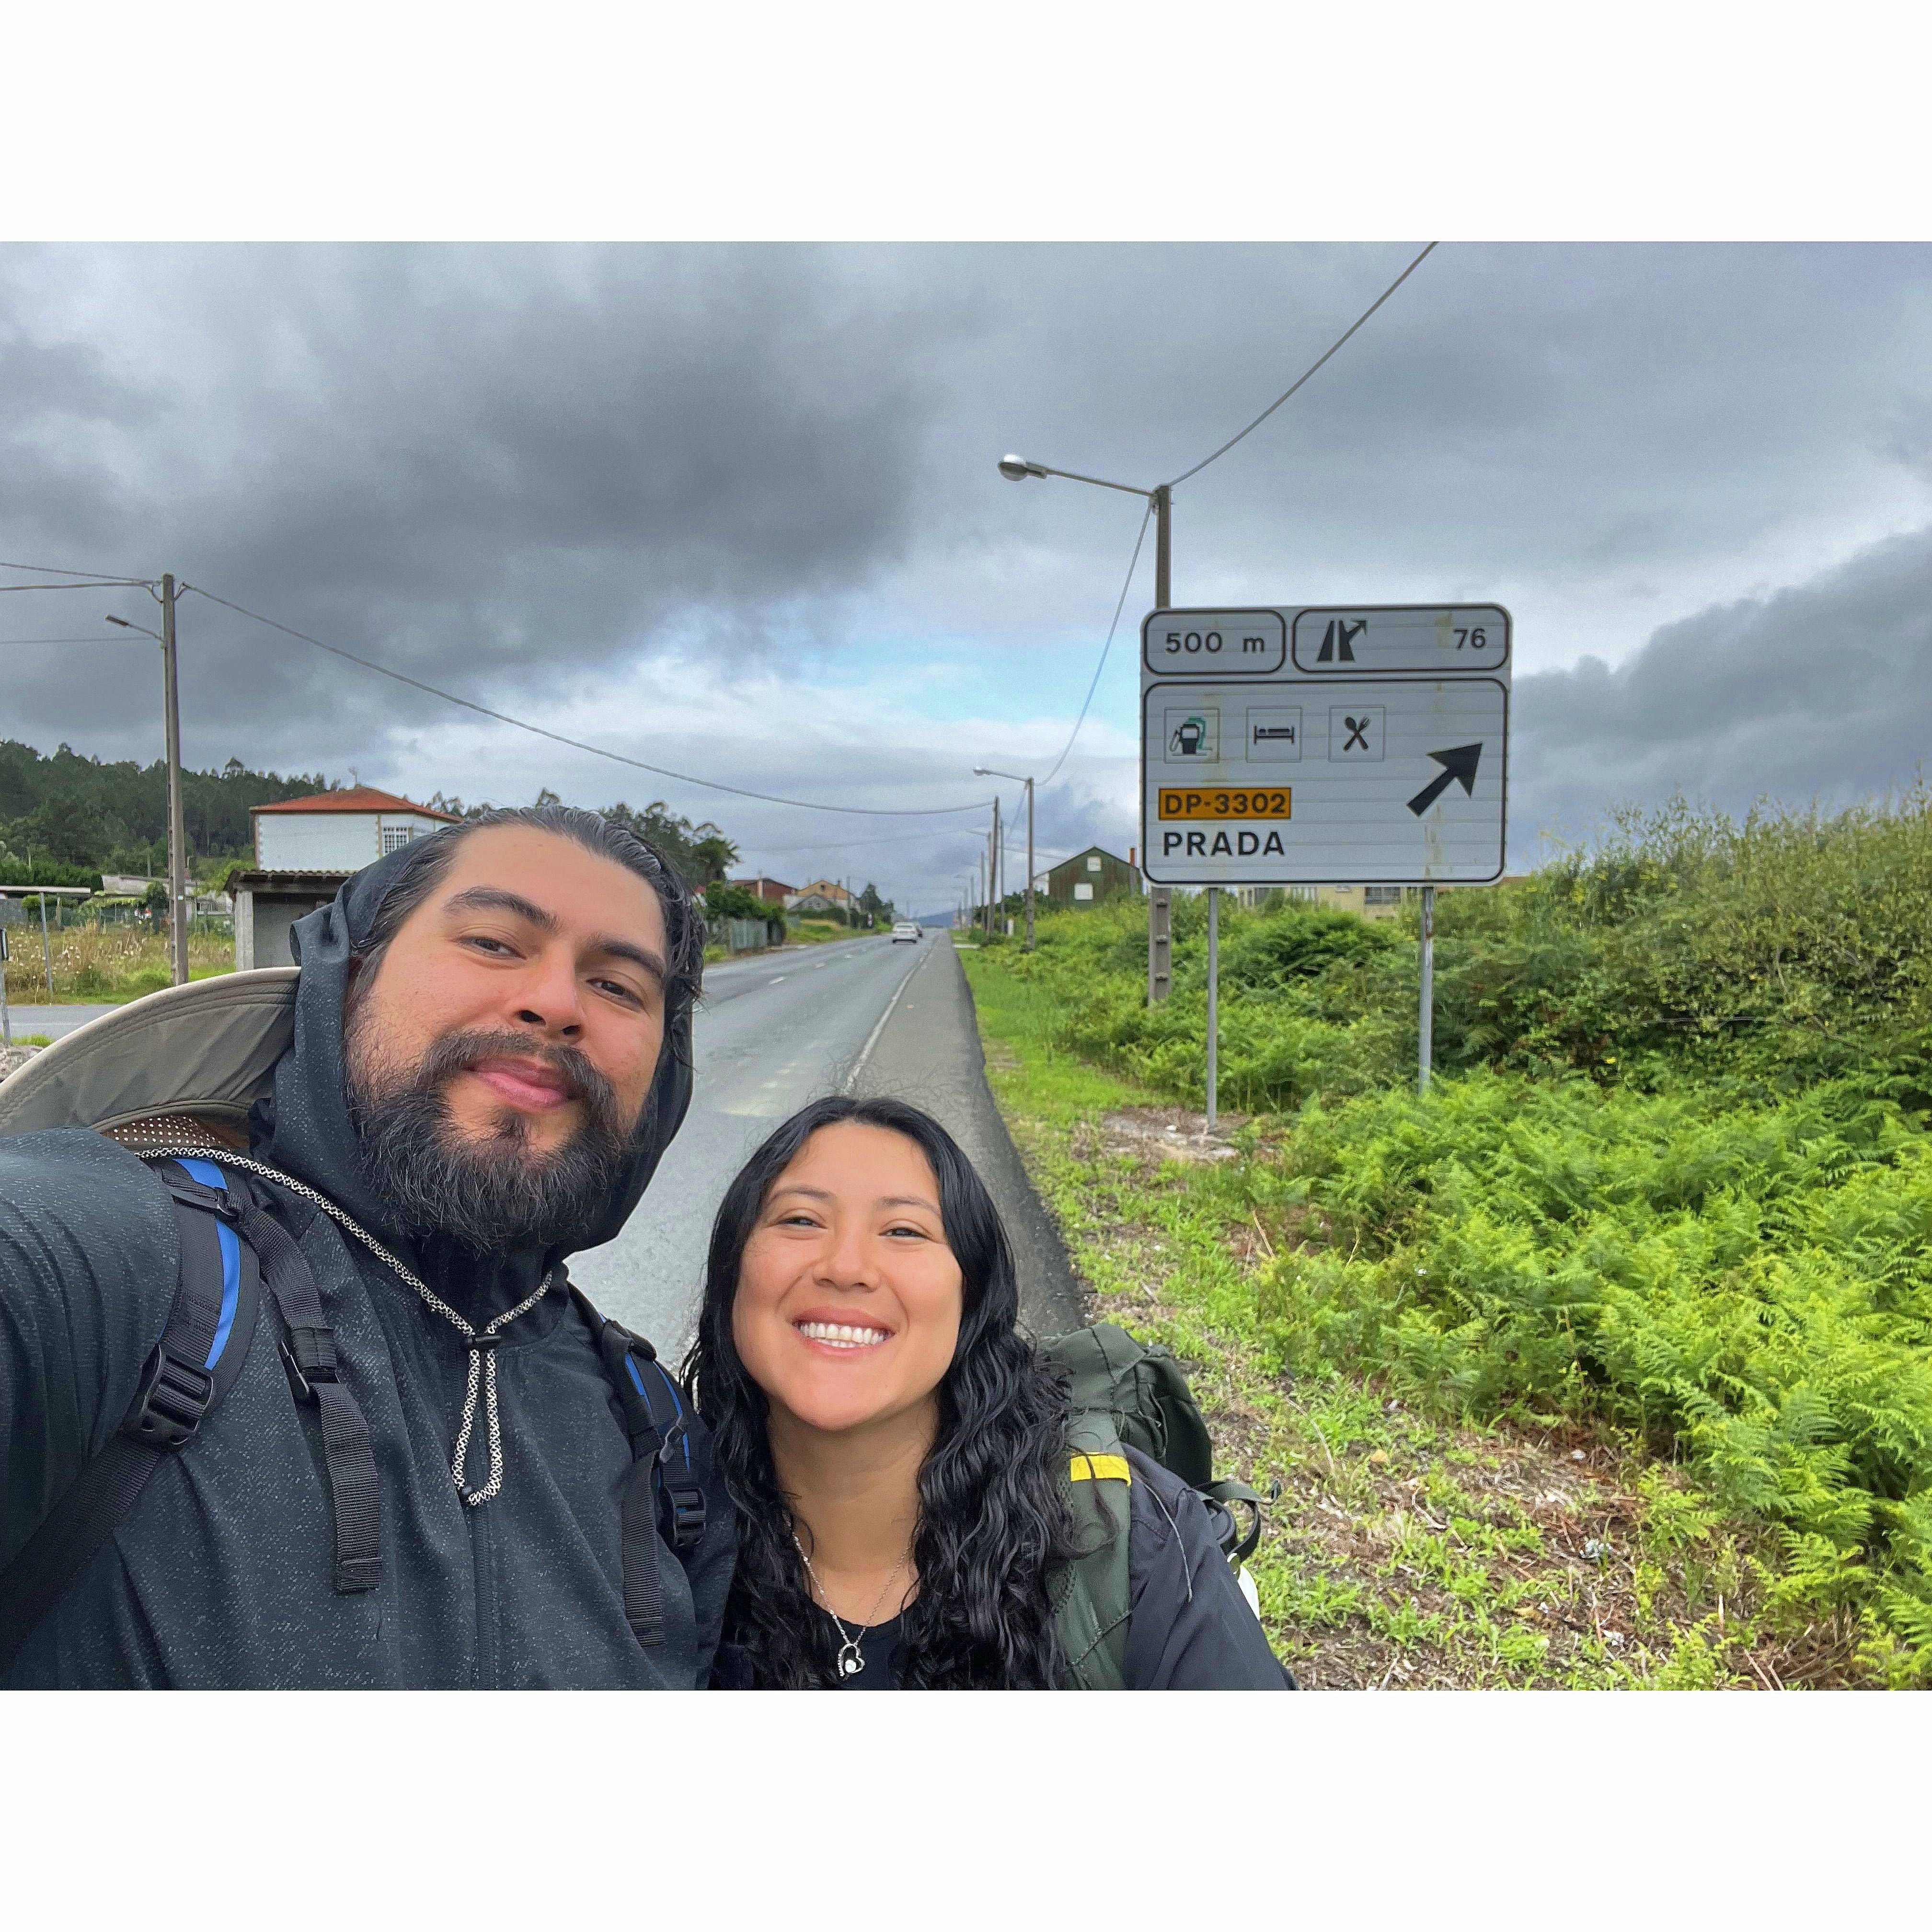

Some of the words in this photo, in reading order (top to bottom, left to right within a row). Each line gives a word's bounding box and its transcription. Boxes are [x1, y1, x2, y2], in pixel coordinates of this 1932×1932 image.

[1166, 632, 1222, 653] 500
[1243, 638, 1265, 652] m
[1454, 628, 1486, 649] 76
[1165, 794, 1285, 814] DP-3302
[1163, 831, 1284, 856] PRADA
